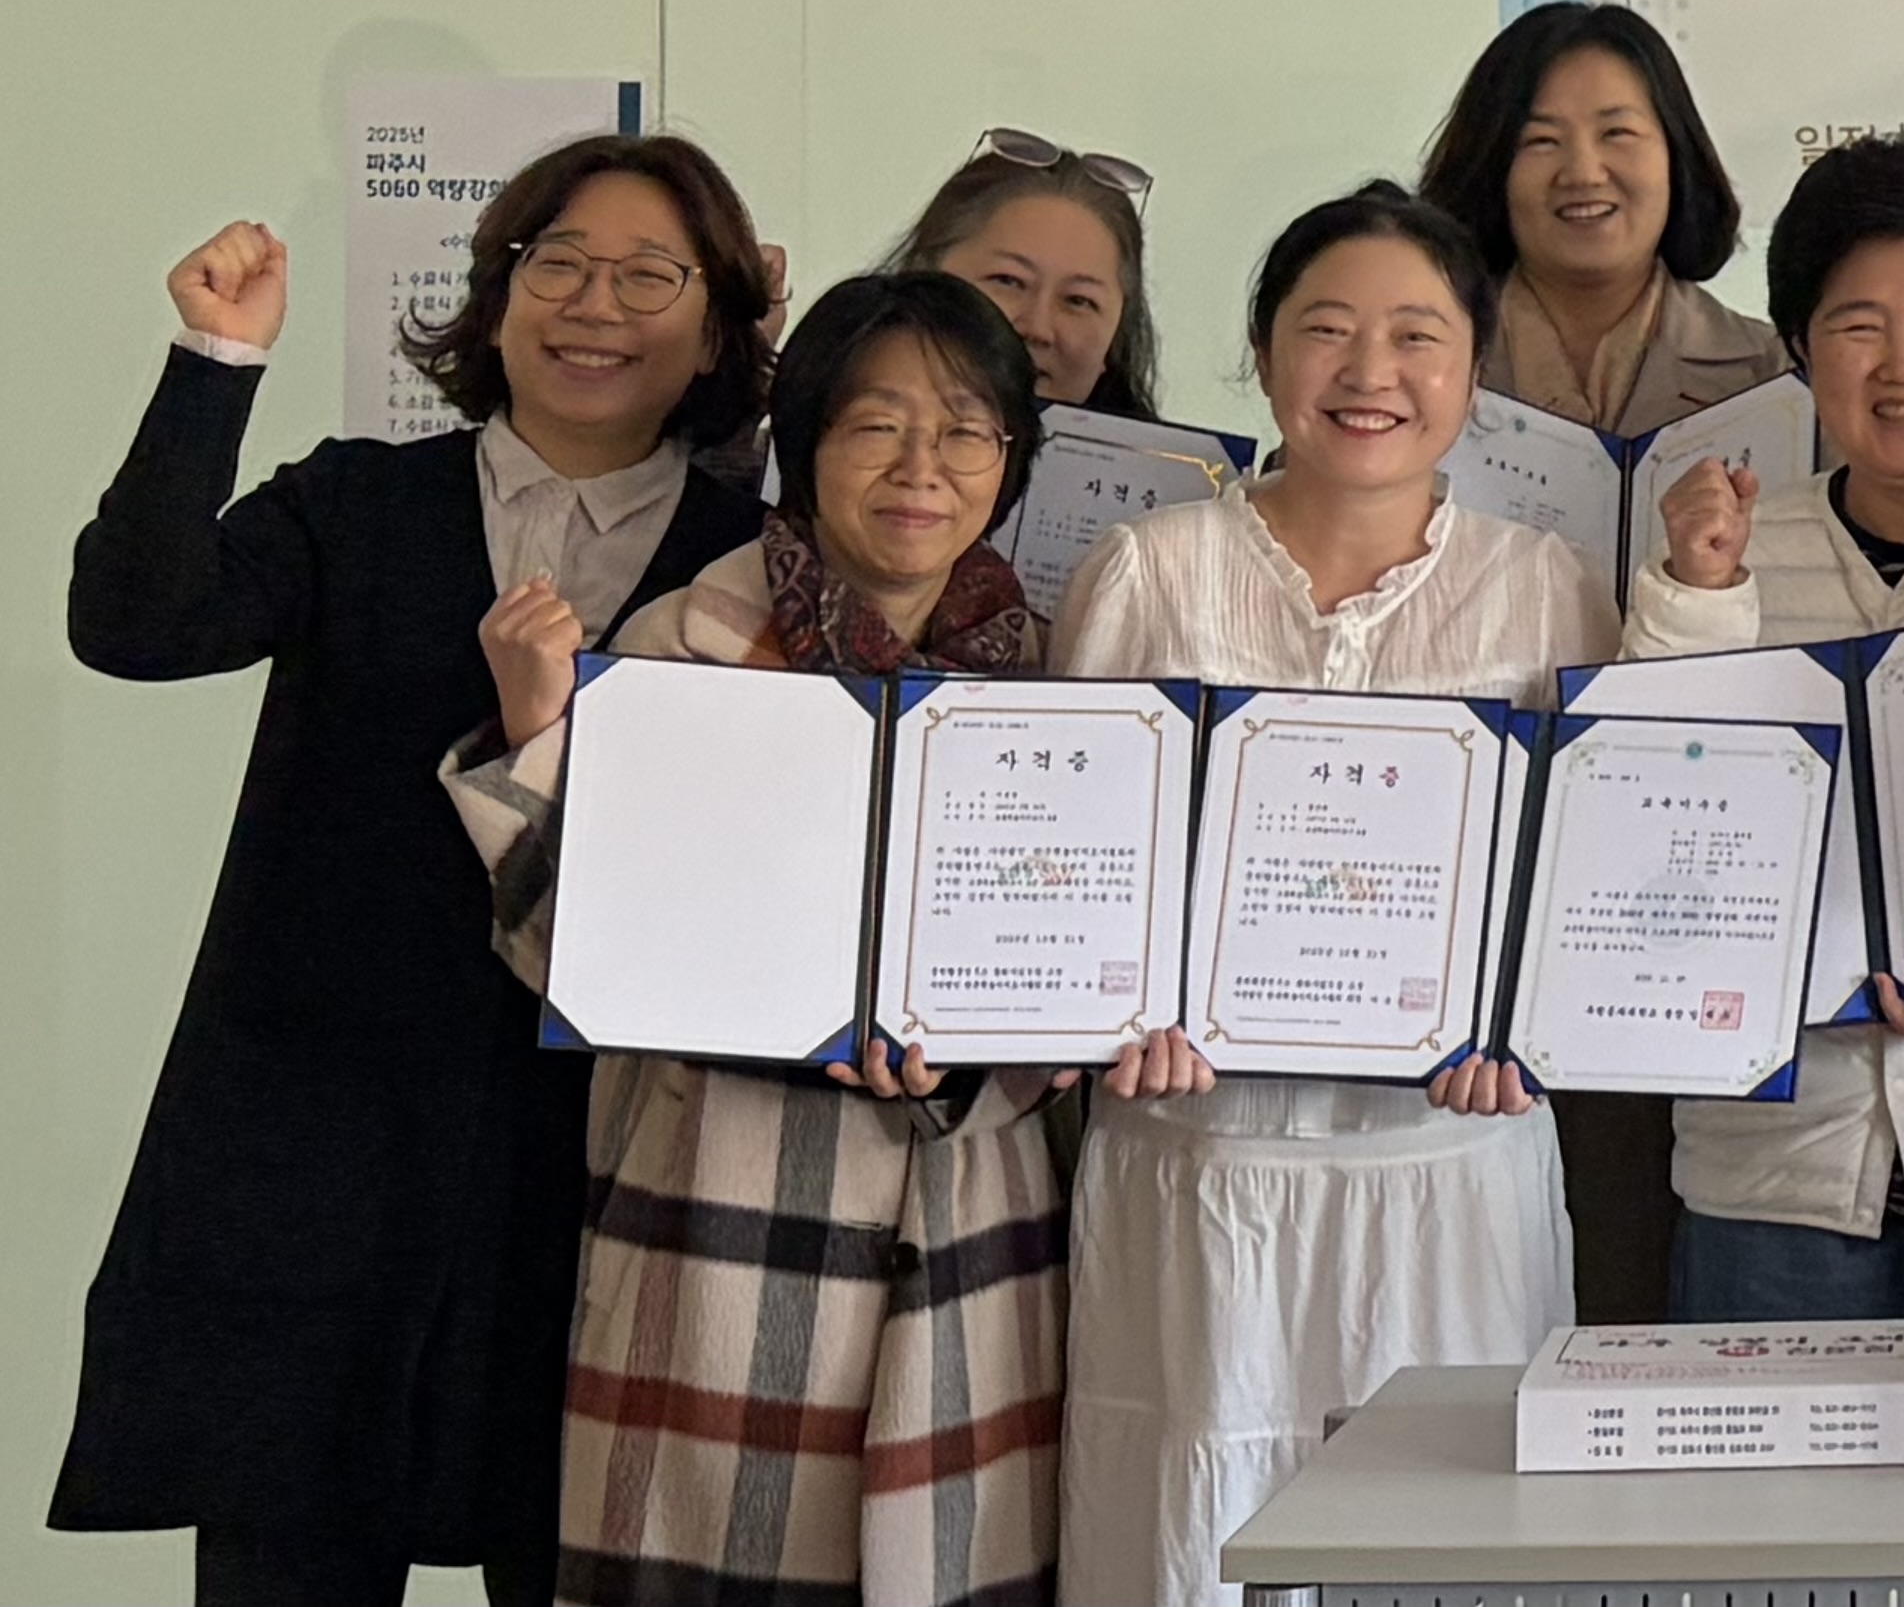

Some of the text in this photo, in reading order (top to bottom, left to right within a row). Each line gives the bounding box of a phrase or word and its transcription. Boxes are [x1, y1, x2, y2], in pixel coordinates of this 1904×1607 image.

[366, 126, 425, 144] 2025년
[366, 153, 426, 174] 파주시
[366, 178, 420, 198] 5060
